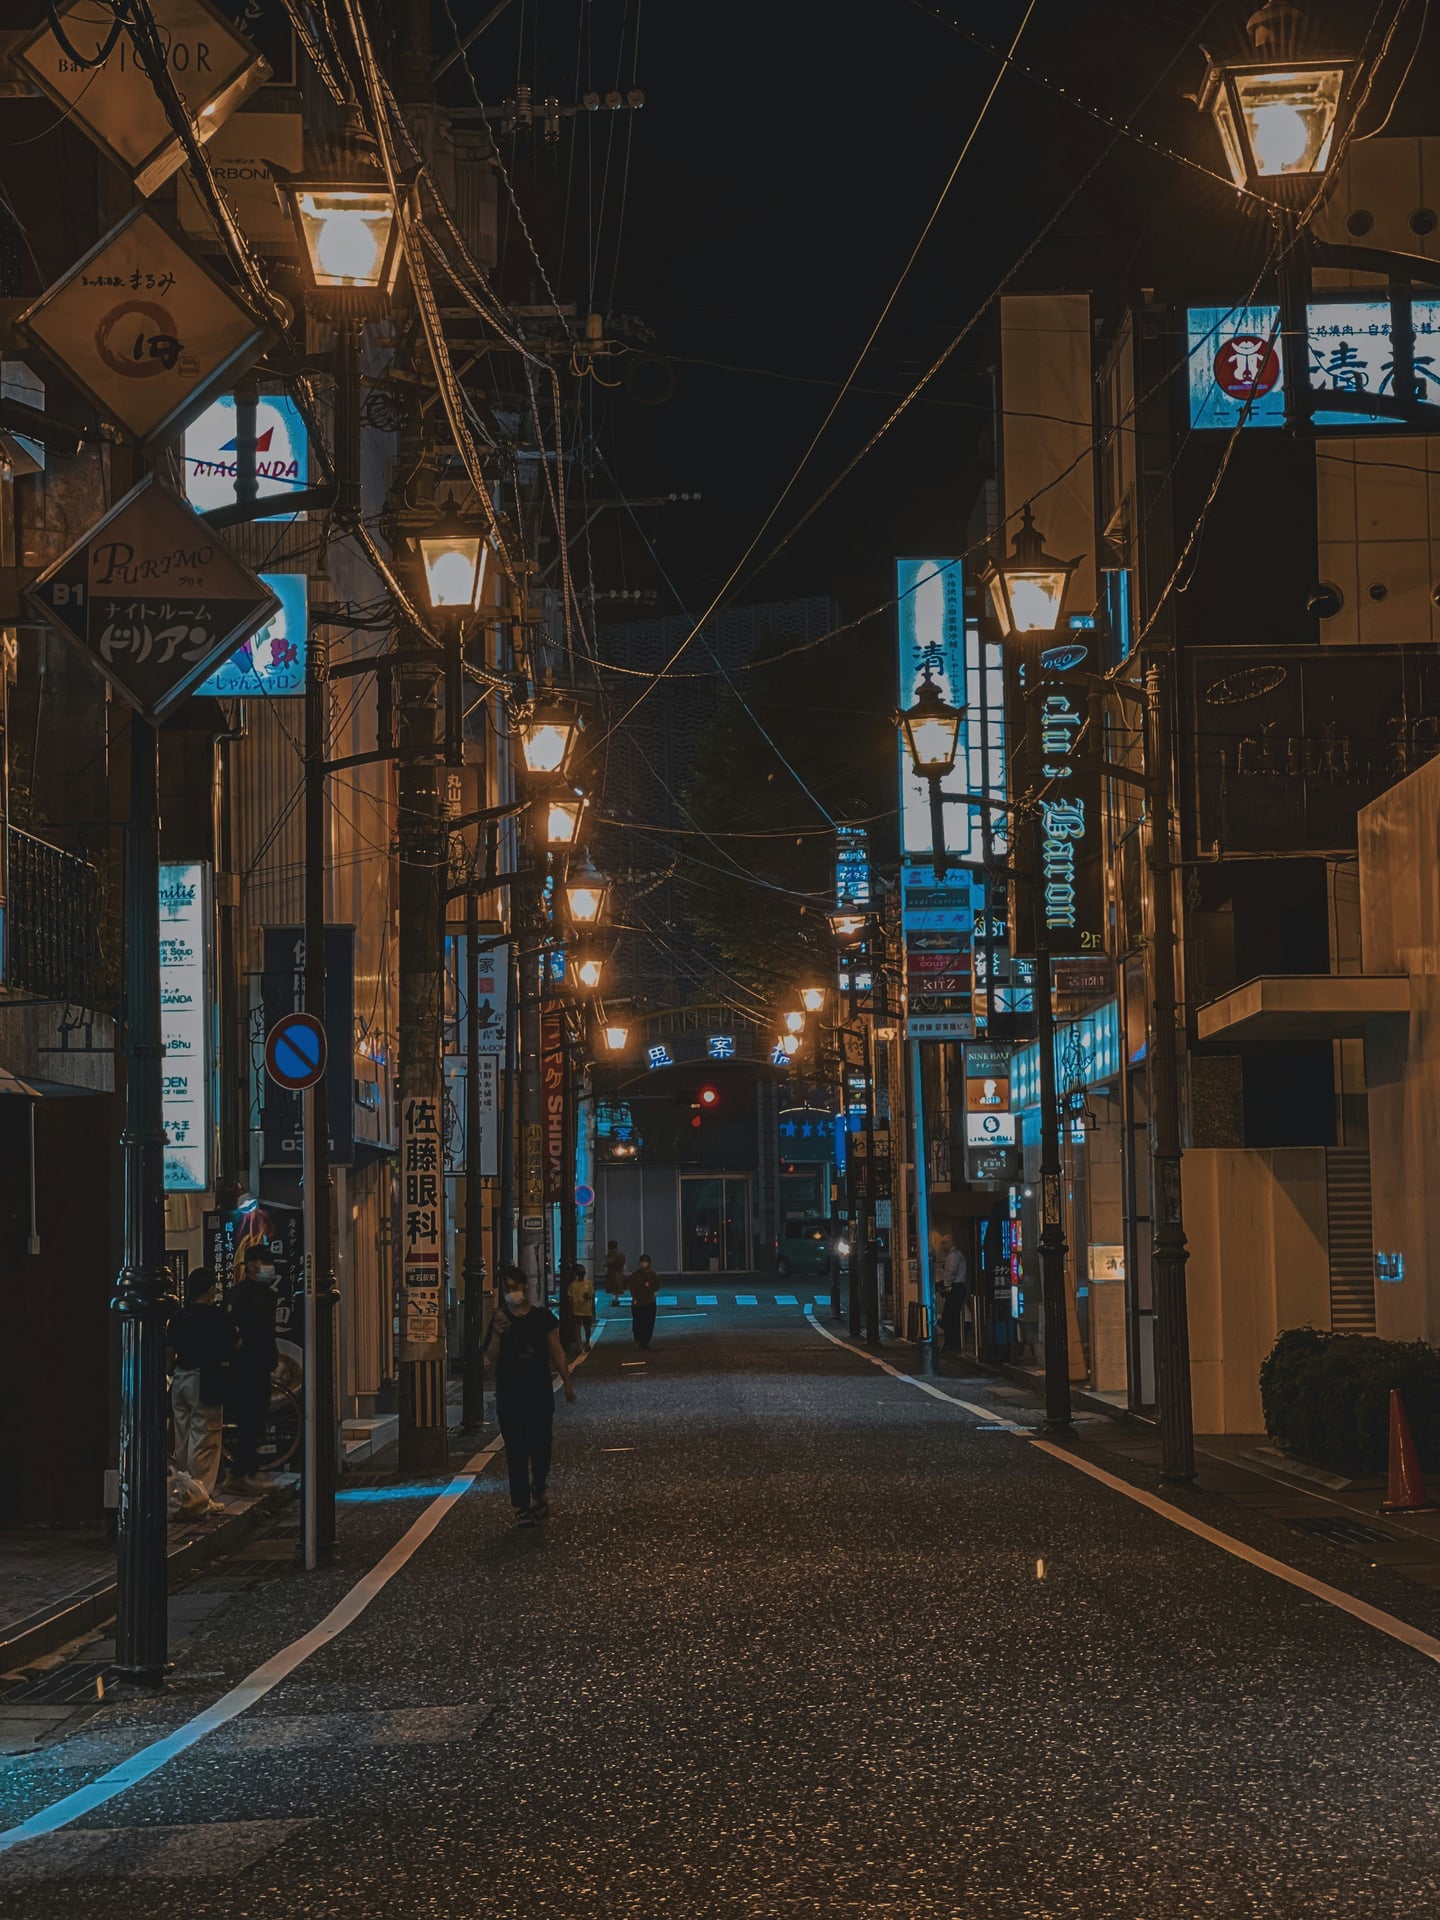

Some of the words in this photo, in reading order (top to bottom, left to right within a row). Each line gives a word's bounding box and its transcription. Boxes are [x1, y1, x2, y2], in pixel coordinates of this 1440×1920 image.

[193, 460, 299, 478] MANDA
[53, 583, 84, 606] B1
[104, 603, 212, 626] ナイトルーム
[99, 624, 216, 665] ドリアン
[912, 641, 948, 676] 清
[1040, 798, 1085, 930] Baron
[1080, 932, 1102, 949] 2F
[405, 1100, 438, 1245] 佐藤眼科
